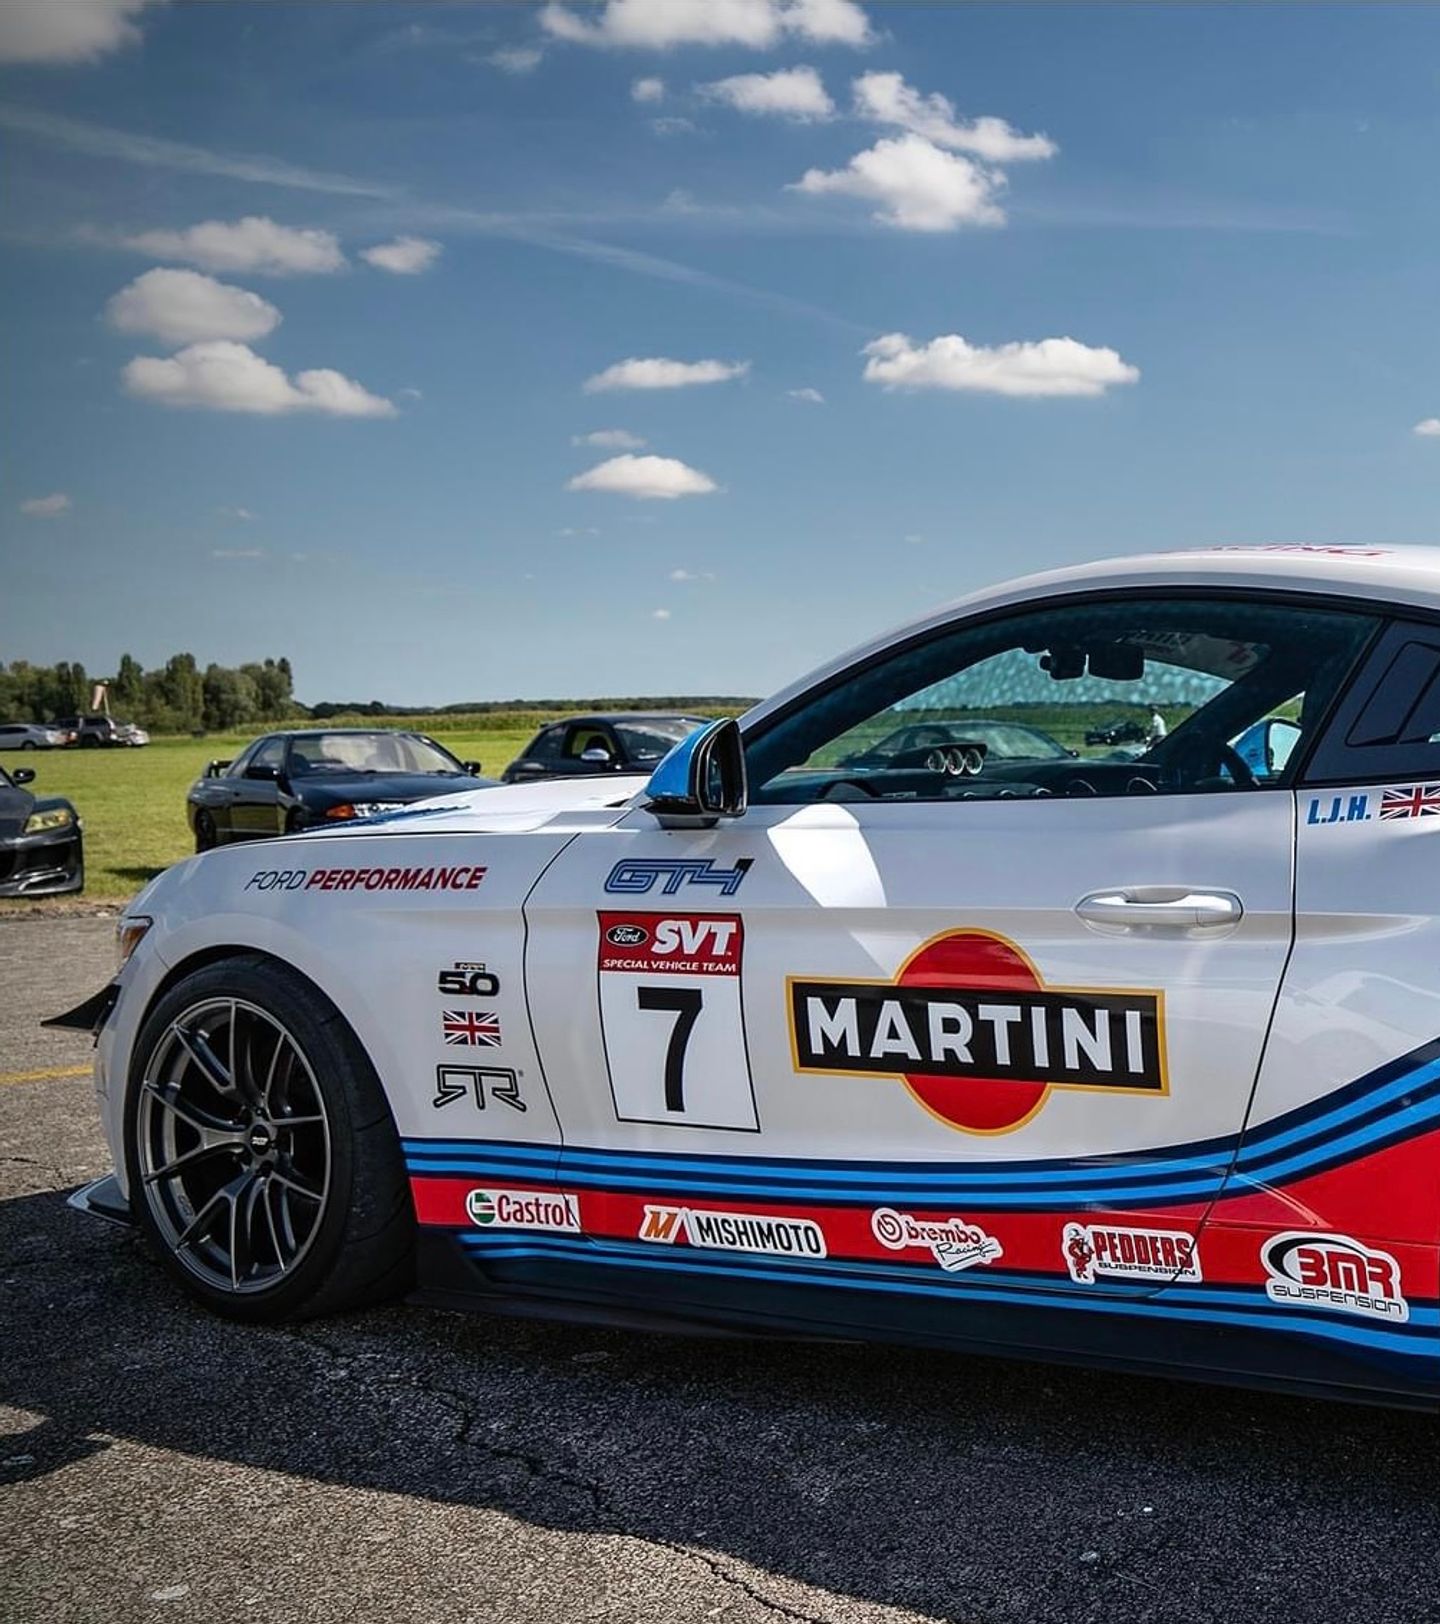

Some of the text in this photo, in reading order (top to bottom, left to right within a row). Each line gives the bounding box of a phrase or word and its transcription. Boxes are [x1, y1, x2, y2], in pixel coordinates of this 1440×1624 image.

[1307, 795, 1372, 825] L.J.H.
[244, 867, 488, 891] FORD PERFORMANCE
[604, 858, 755, 895] GT4
[613, 927, 641, 943] Ford
[651, 920, 737, 956] SVT
[603, 959, 736, 972] SPECIAL VEHICLE TEAM
[637, 987, 702, 1112] 7
[806, 996, 1145, 1074] MARTINI
[498, 1193, 575, 1228] Castrol
[696, 1215, 822, 1255] MISHIMOTO
[905, 1220, 981, 1244] brembo
[1092, 1231, 1194, 1268] PEDDERS
[1098, 1262, 1195, 1276] SUSPENSION
[1273, 1285, 1402, 1314] SUSPENSION
